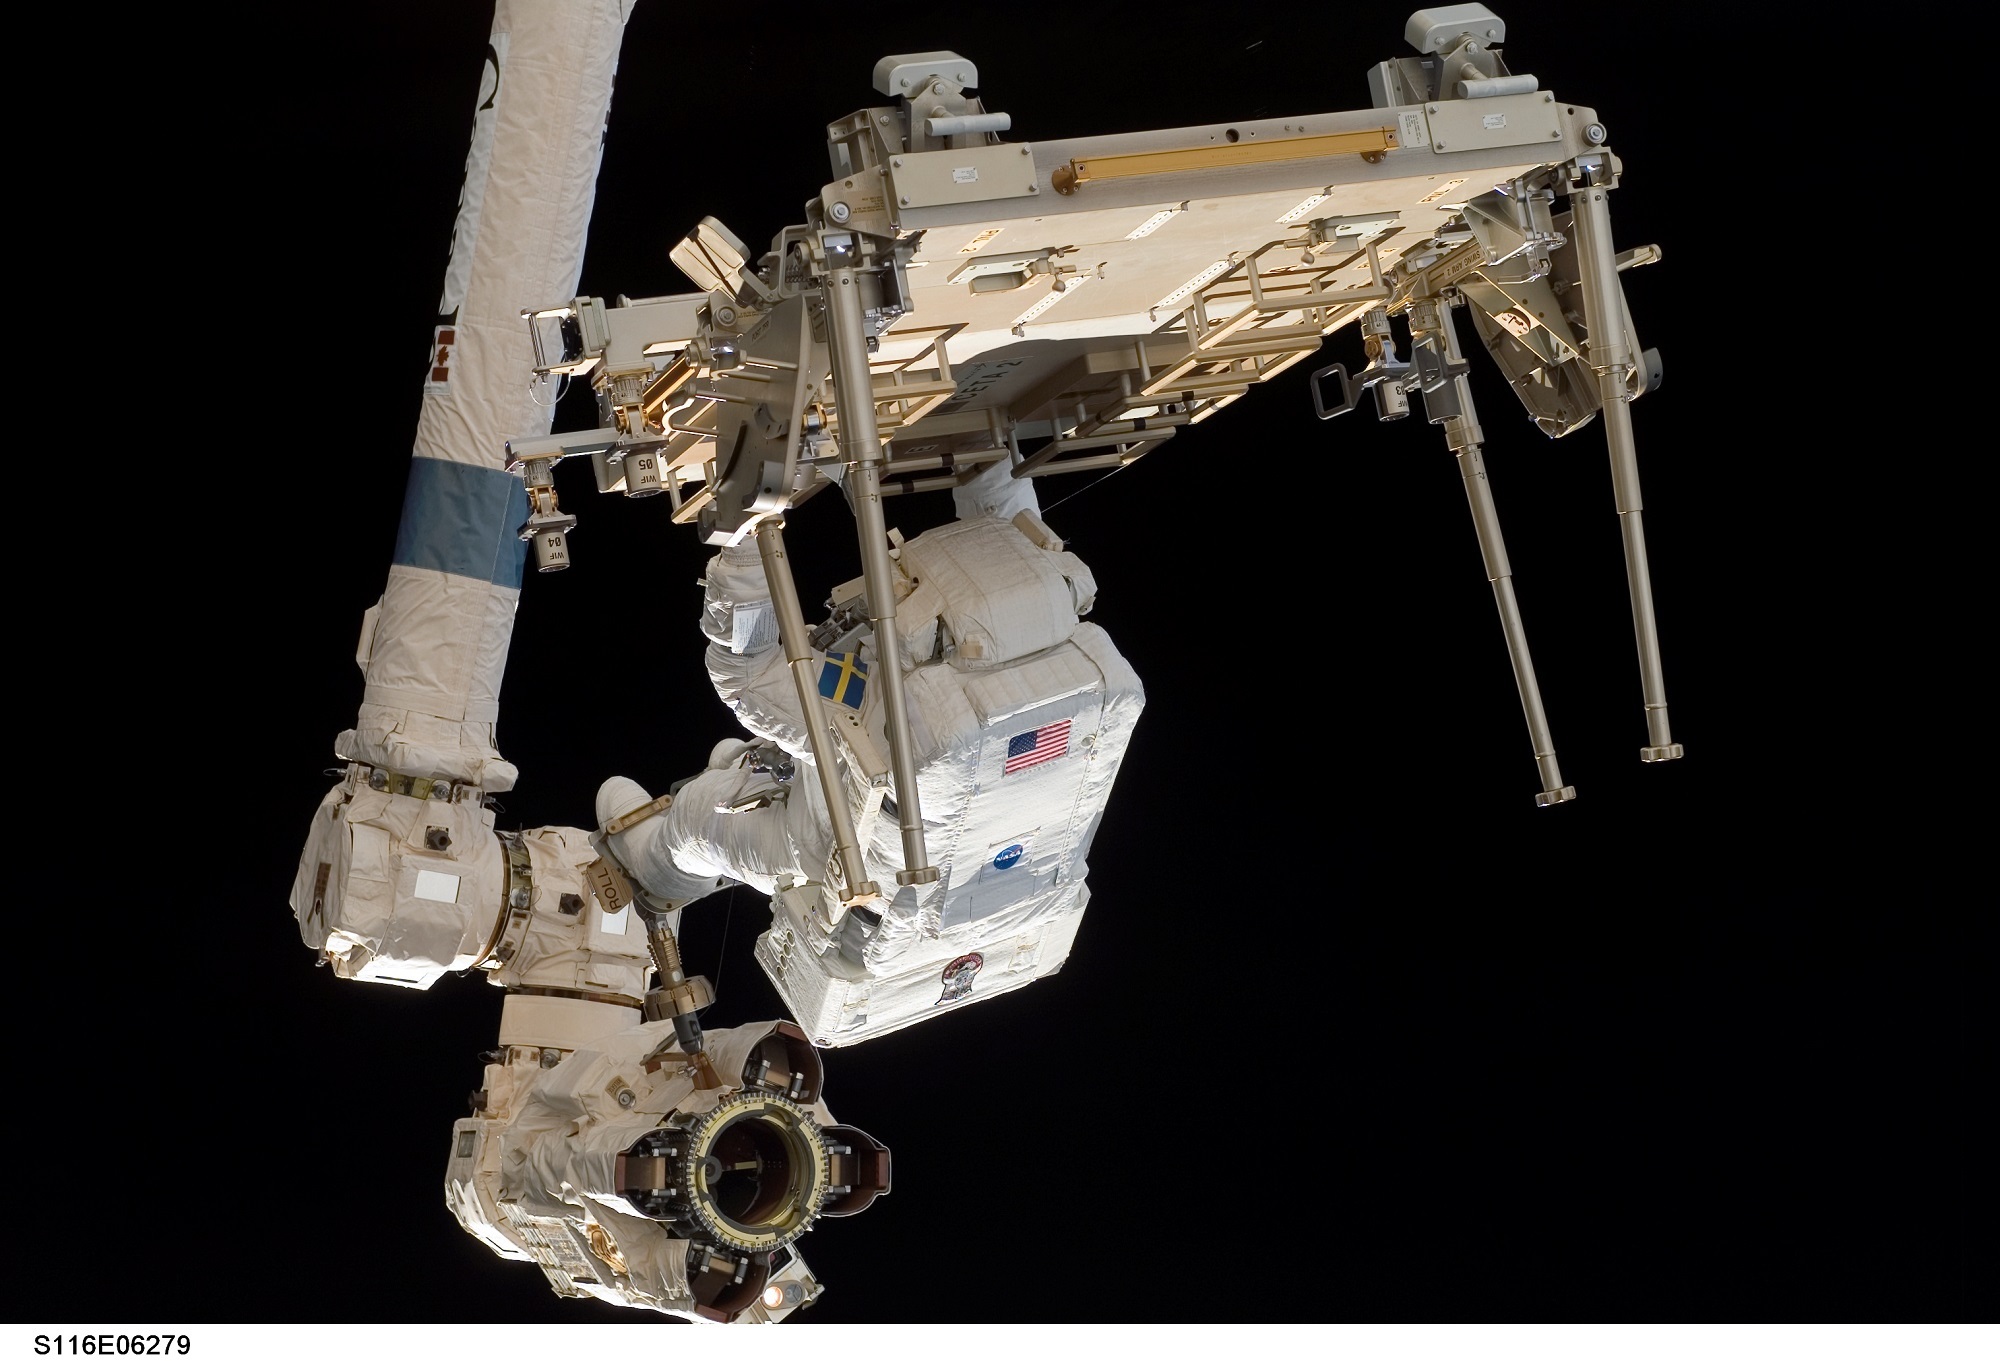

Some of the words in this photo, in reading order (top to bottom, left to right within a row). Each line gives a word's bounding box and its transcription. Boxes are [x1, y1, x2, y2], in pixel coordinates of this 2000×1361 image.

[1463, 250, 1480, 267] SWING
[1451, 260, 1463, 274] ARM
[951, 371, 1009, 401] CETA
[638, 458, 653, 470] 05
[640, 474, 657, 484] WIF
[547, 536, 561, 548] 04
[549, 551, 565, 561] WIF
[598, 867, 622, 910] ROLL
